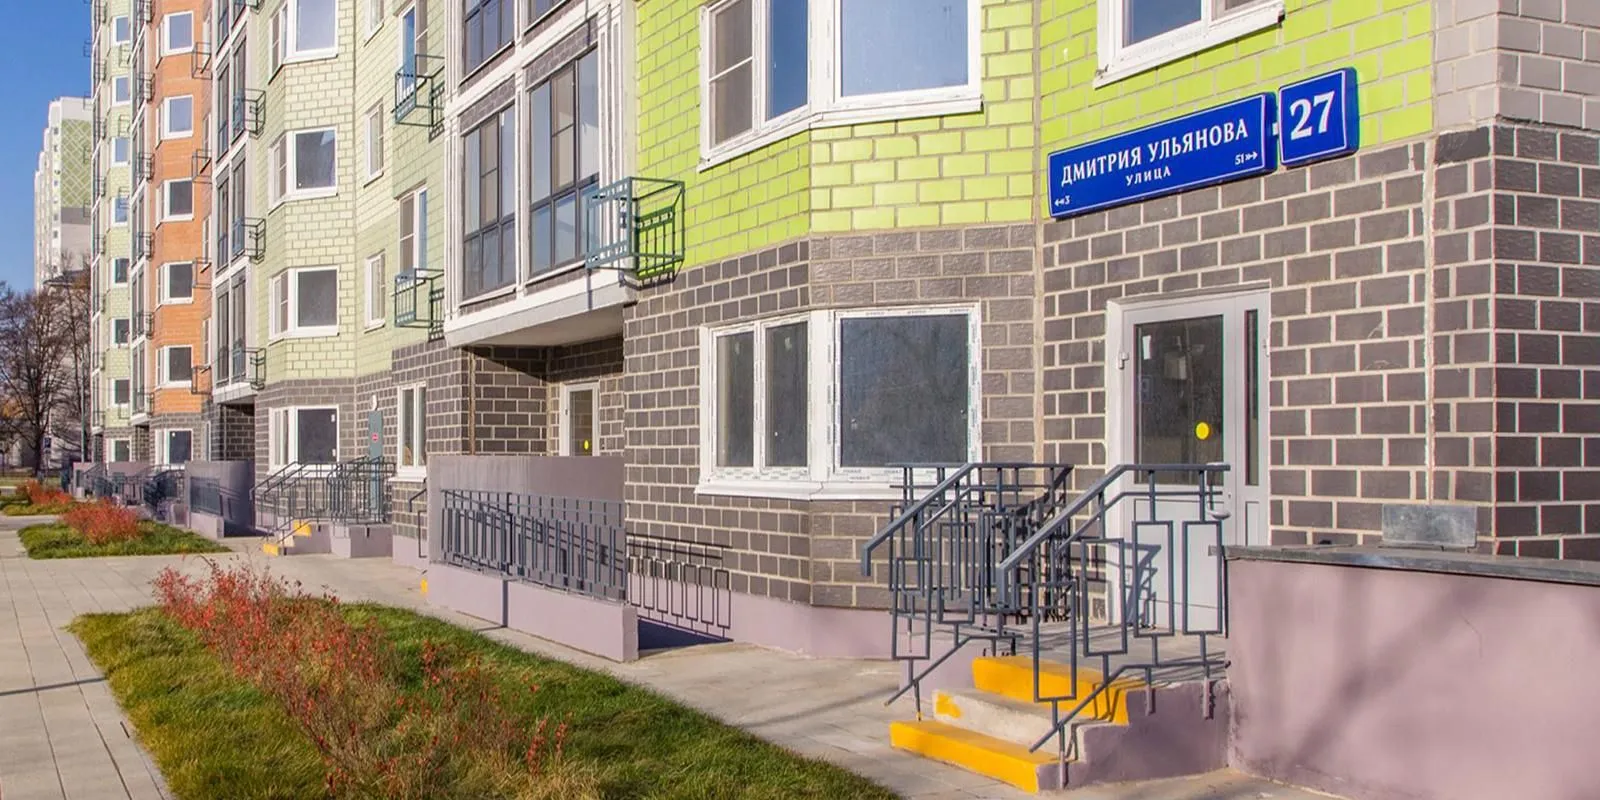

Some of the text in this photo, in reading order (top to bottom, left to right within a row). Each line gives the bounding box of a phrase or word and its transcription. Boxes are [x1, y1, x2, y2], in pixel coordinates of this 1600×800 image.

[1290, 90, 1335, 140] 27
[1061, 118, 1248, 187] ДМИТРИЯ УЛЬЯНОВА
[1234, 153, 1244, 166] 51
[1125, 165, 1172, 187] УЛИЦА
